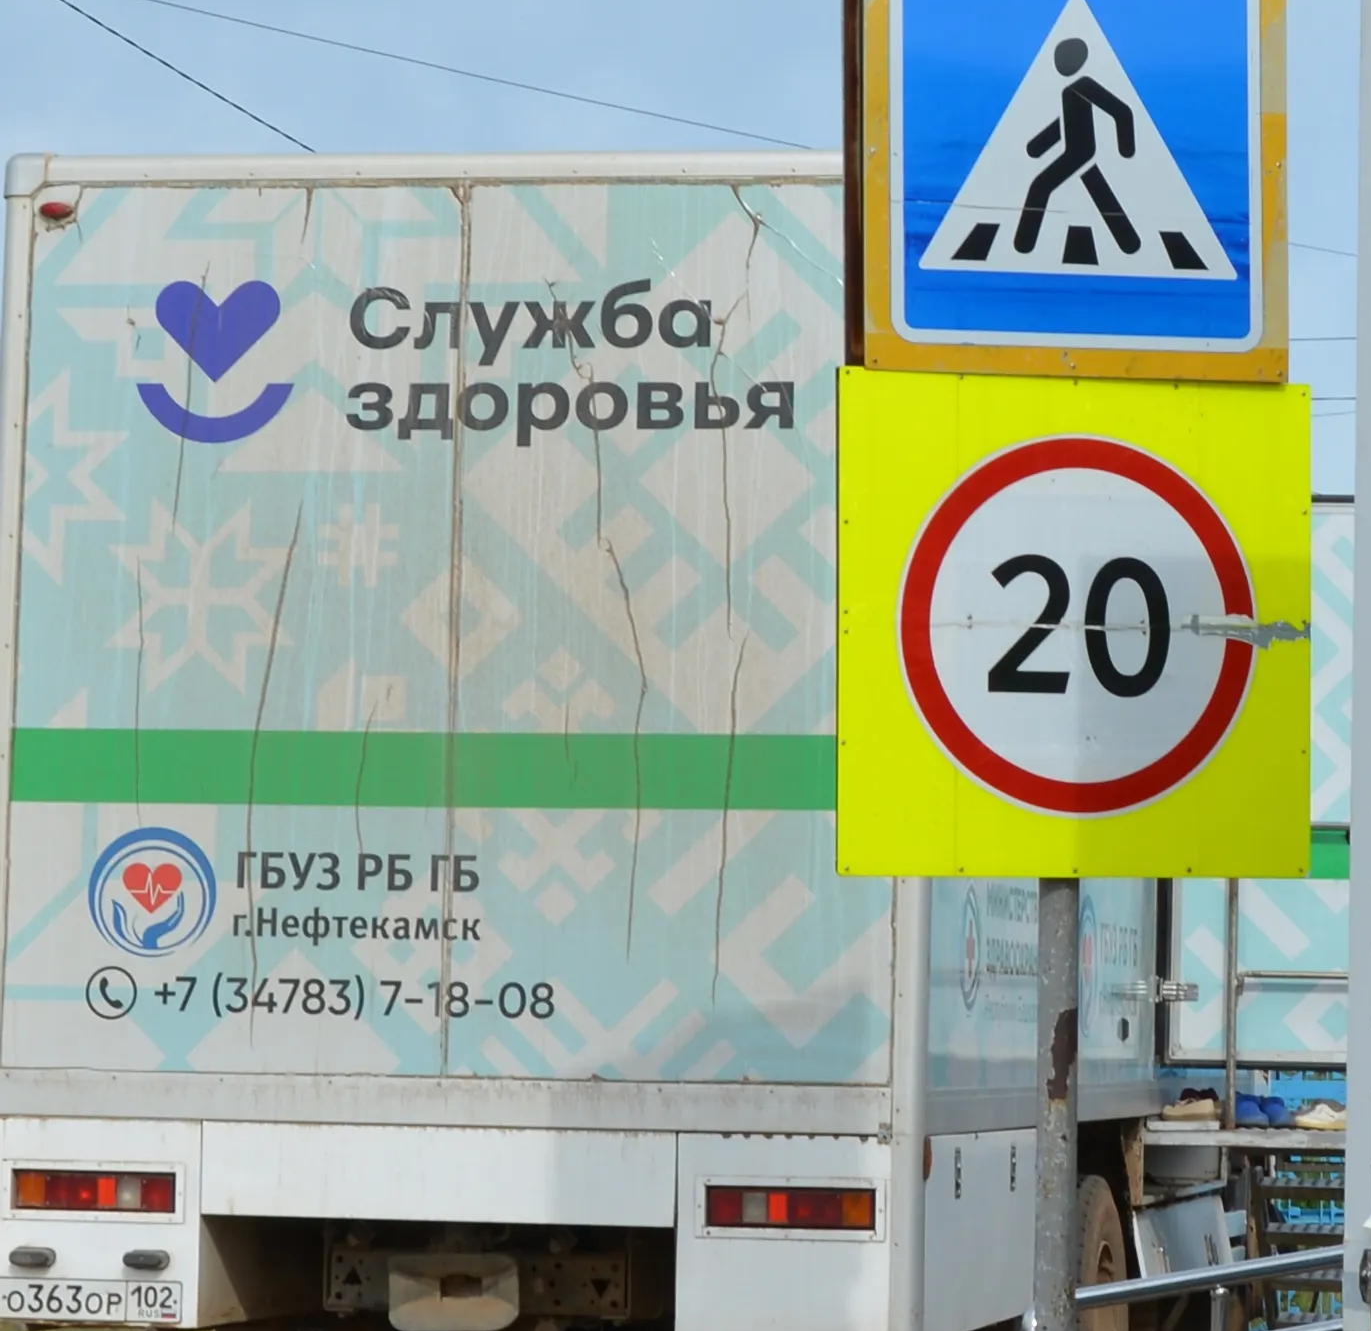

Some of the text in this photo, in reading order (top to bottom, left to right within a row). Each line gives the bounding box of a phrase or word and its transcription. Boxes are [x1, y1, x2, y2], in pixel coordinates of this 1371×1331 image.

[349, 278, 713, 366] Служба
[346, 380, 795, 447] здоровья
[987, 553, 1171, 698] 20
[236, 850, 480, 893] ГБУЗ РБ ГБ
[232, 906, 481, 947] г.Нефтекамск
[153, 972, 556, 1020] +7 (34783) 7-18-08
[7, 1283, 173, 1316] О363ОР 102
[138, 1310, 161, 1319] RUS
